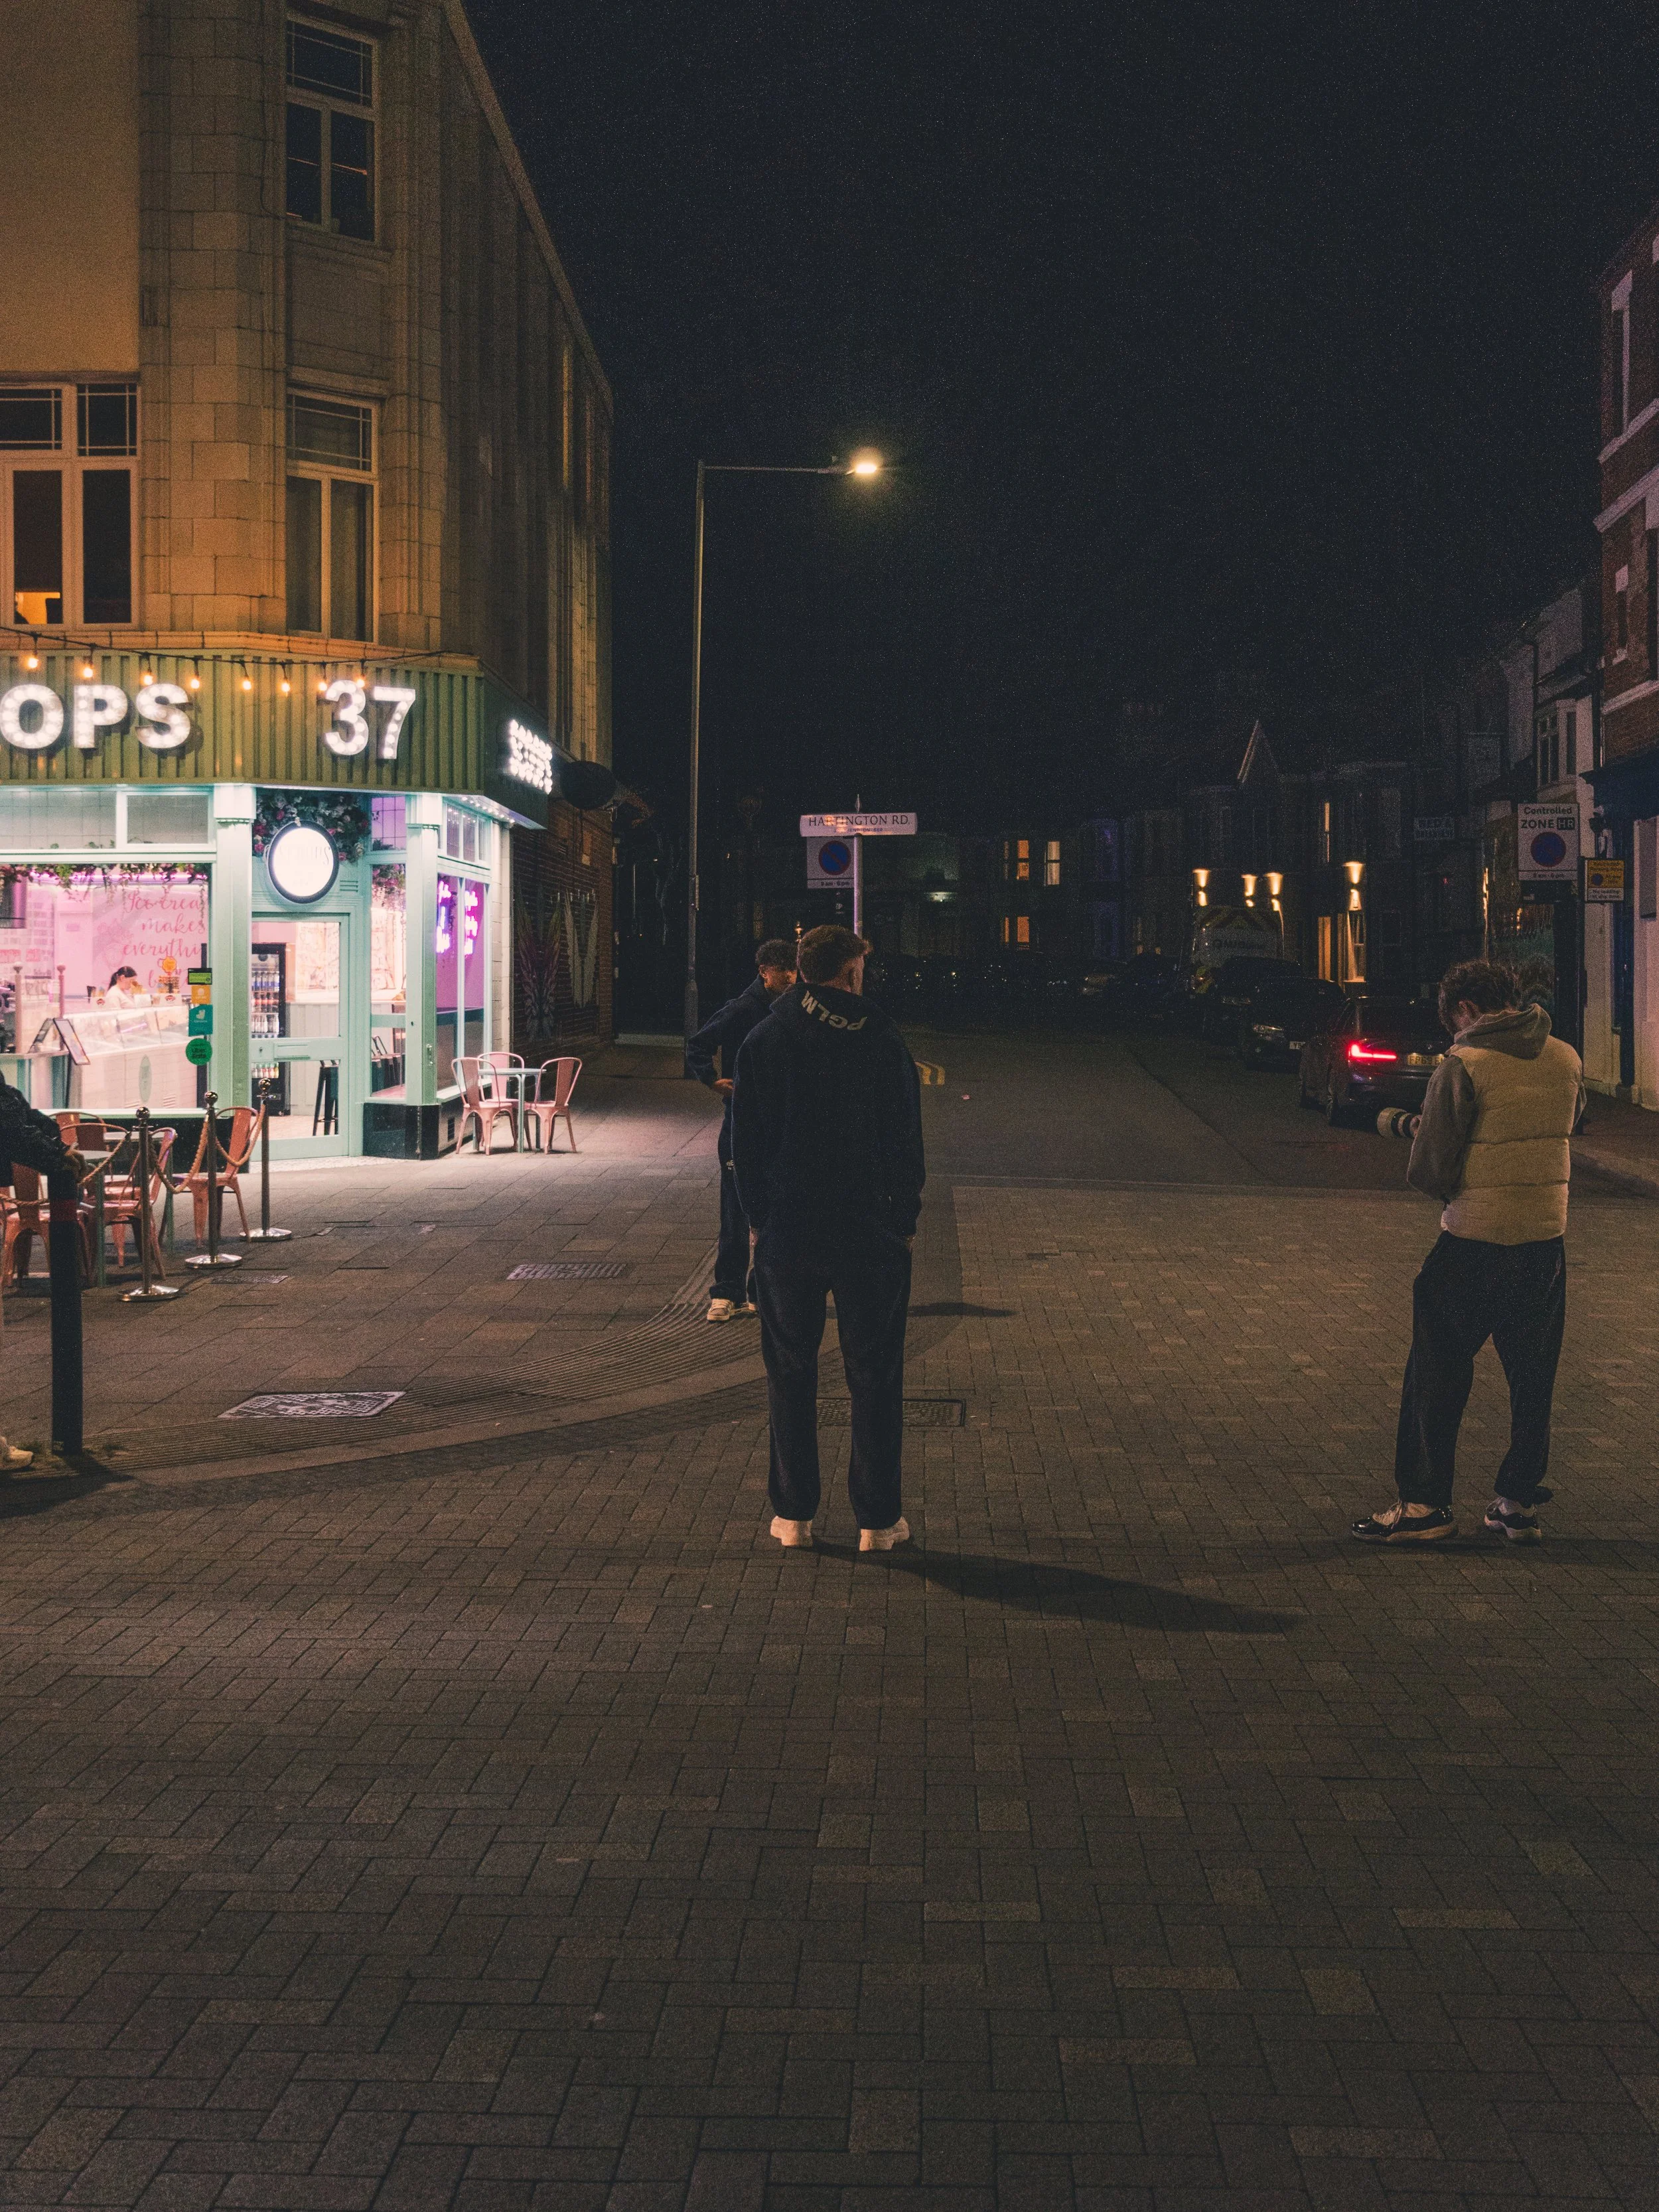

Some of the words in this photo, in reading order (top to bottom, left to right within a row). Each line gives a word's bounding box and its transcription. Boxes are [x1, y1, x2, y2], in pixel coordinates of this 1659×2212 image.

[1, 684, 191, 749] OPS
[324, 680, 415, 759] 37
[809, 815, 887, 826] HARTINGTON
[1521, 820, 1554, 828] ZONE
[1558, 819, 1575, 828] HR
[123, 938, 202, 960] everythi
